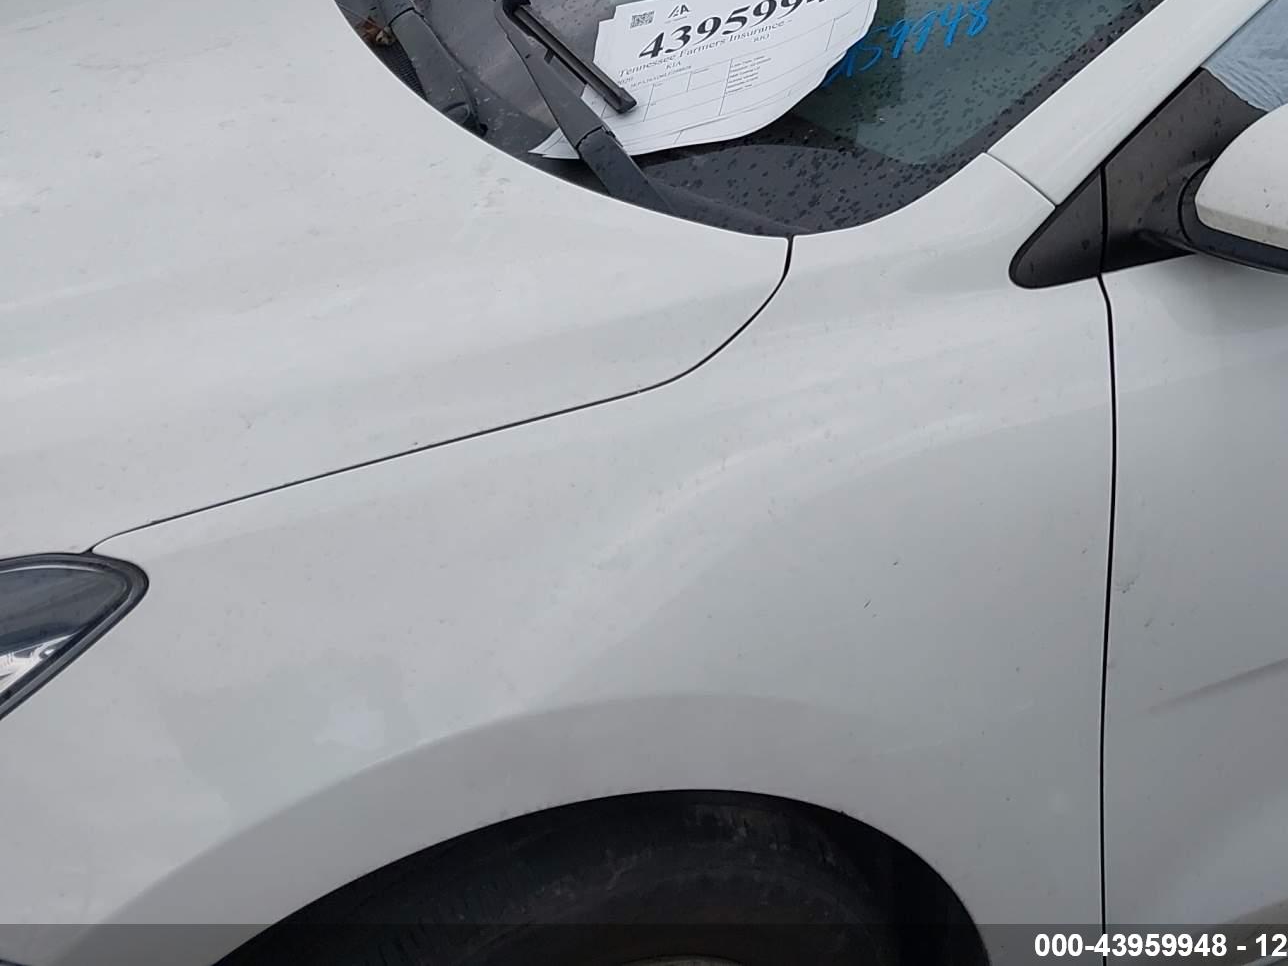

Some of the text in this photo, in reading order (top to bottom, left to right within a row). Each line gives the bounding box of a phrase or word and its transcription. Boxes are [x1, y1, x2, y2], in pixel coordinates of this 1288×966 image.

[619, 55, 676, 76] Tennessee
[679, 37, 727, 58] Farmers
[729, 20, 785, 42] Insurance
